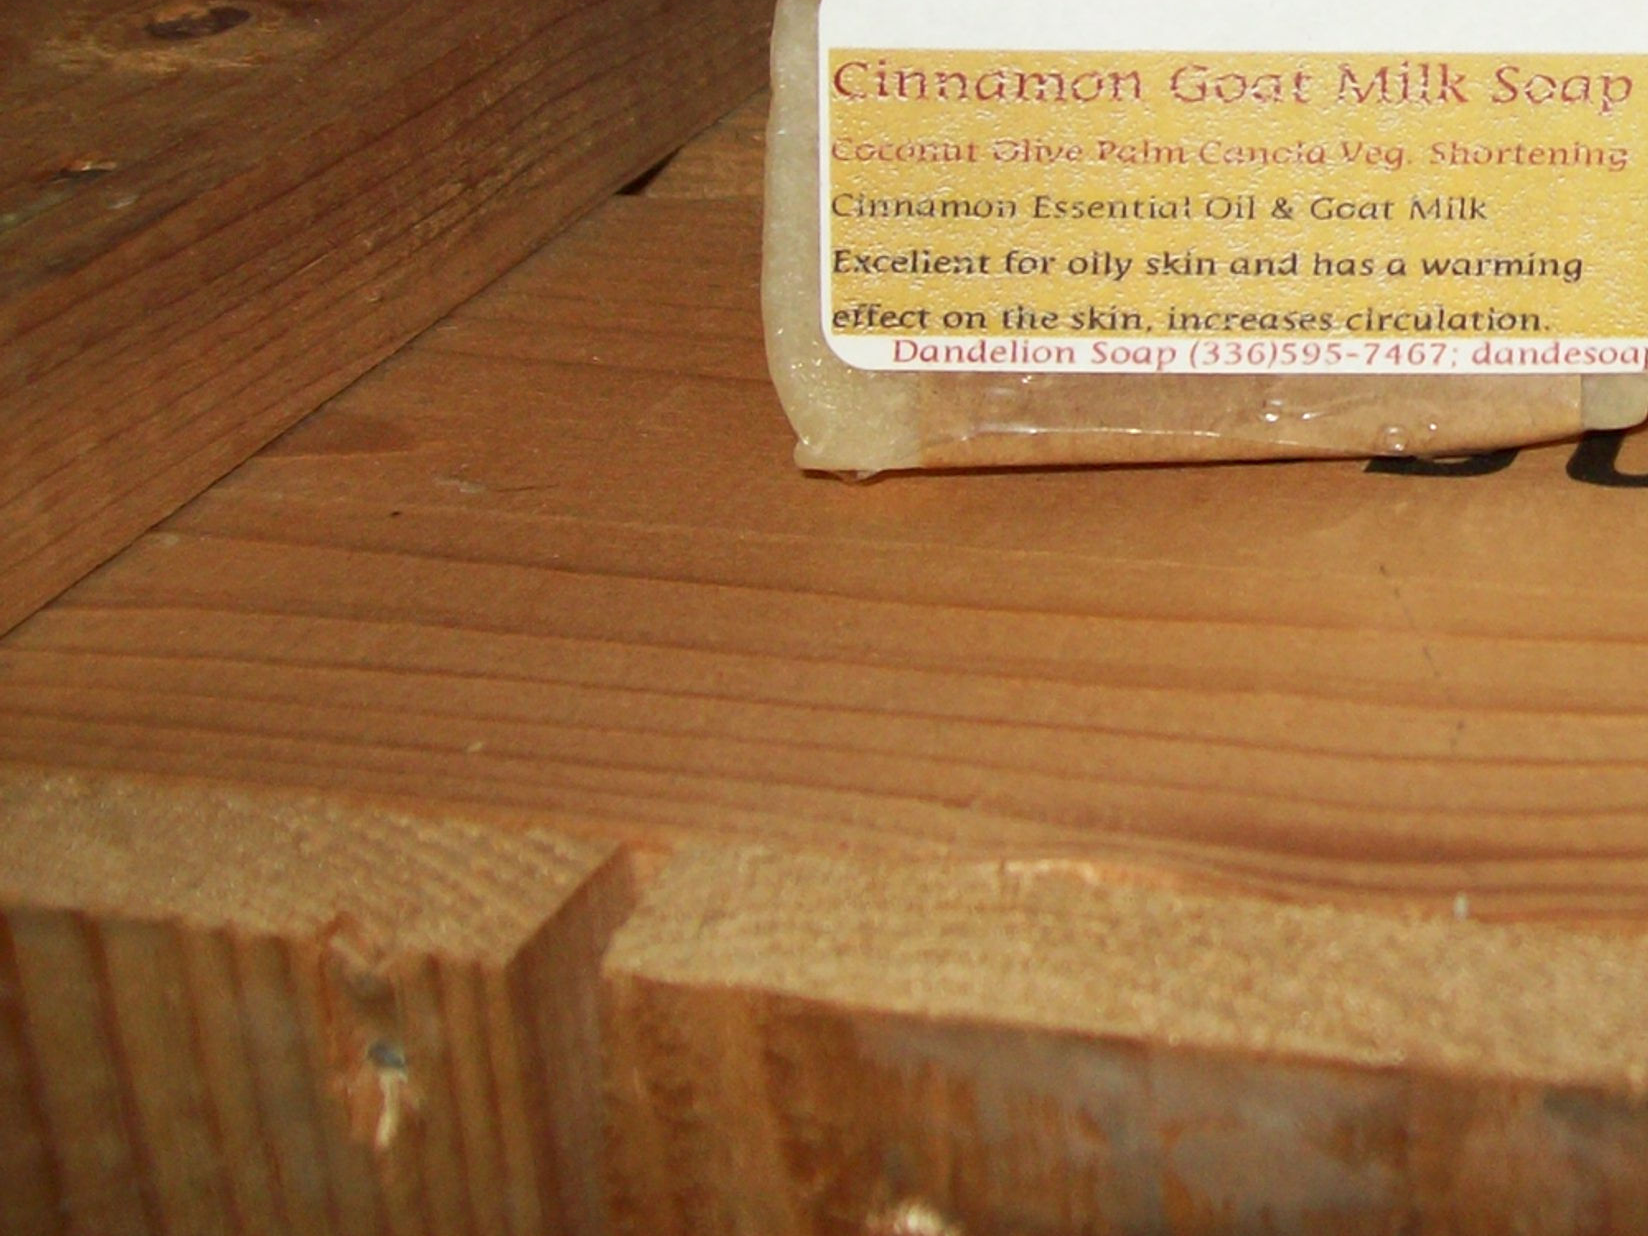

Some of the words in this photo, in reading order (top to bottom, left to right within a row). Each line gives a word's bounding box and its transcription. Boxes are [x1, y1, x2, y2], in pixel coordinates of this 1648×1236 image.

[832, 58, 1142, 103] Cinnamon
[1169, 64, 1312, 104] Goat
[1338, 61, 1468, 104] Milk
[1490, 64, 1634, 115] Soap
[831, 136, 978, 164] Coconut
[992, 137, 1084, 164] Olive
[1098, 139, 1187, 164] Palm
[1341, 141, 1412, 171] Veg.
[1430, 141, 1631, 173] Shortening
[831, 193, 1018, 220] Cinnamon
[1032, 195, 1192, 221] Essential
[1205, 196, 1256, 221] Oil
[1270, 197, 1295, 221] &
[1310, 197, 1396, 222] Goat
[1409, 196, 1489, 222] Milk
[1004, 250, 1056, 276] for
[1066, 251, 1133, 282] oily
[1146, 250, 1218, 276] skin
[1229, 251, 1299, 277] and
[1312, 252, 1375, 277] has
[1385, 258, 1408, 277] a
[1422, 252, 1585, 284] warming
[831, 303, 931, 330] effect
[942, 311, 988, 331] on
[1002, 305, 1060, 331] the
[1167, 307, 1334, 333] increases
[1345, 307, 1551, 333] circulation.
[892, 339, 1077, 366] Dandelion
[1091, 341, 1178, 372] Soap
